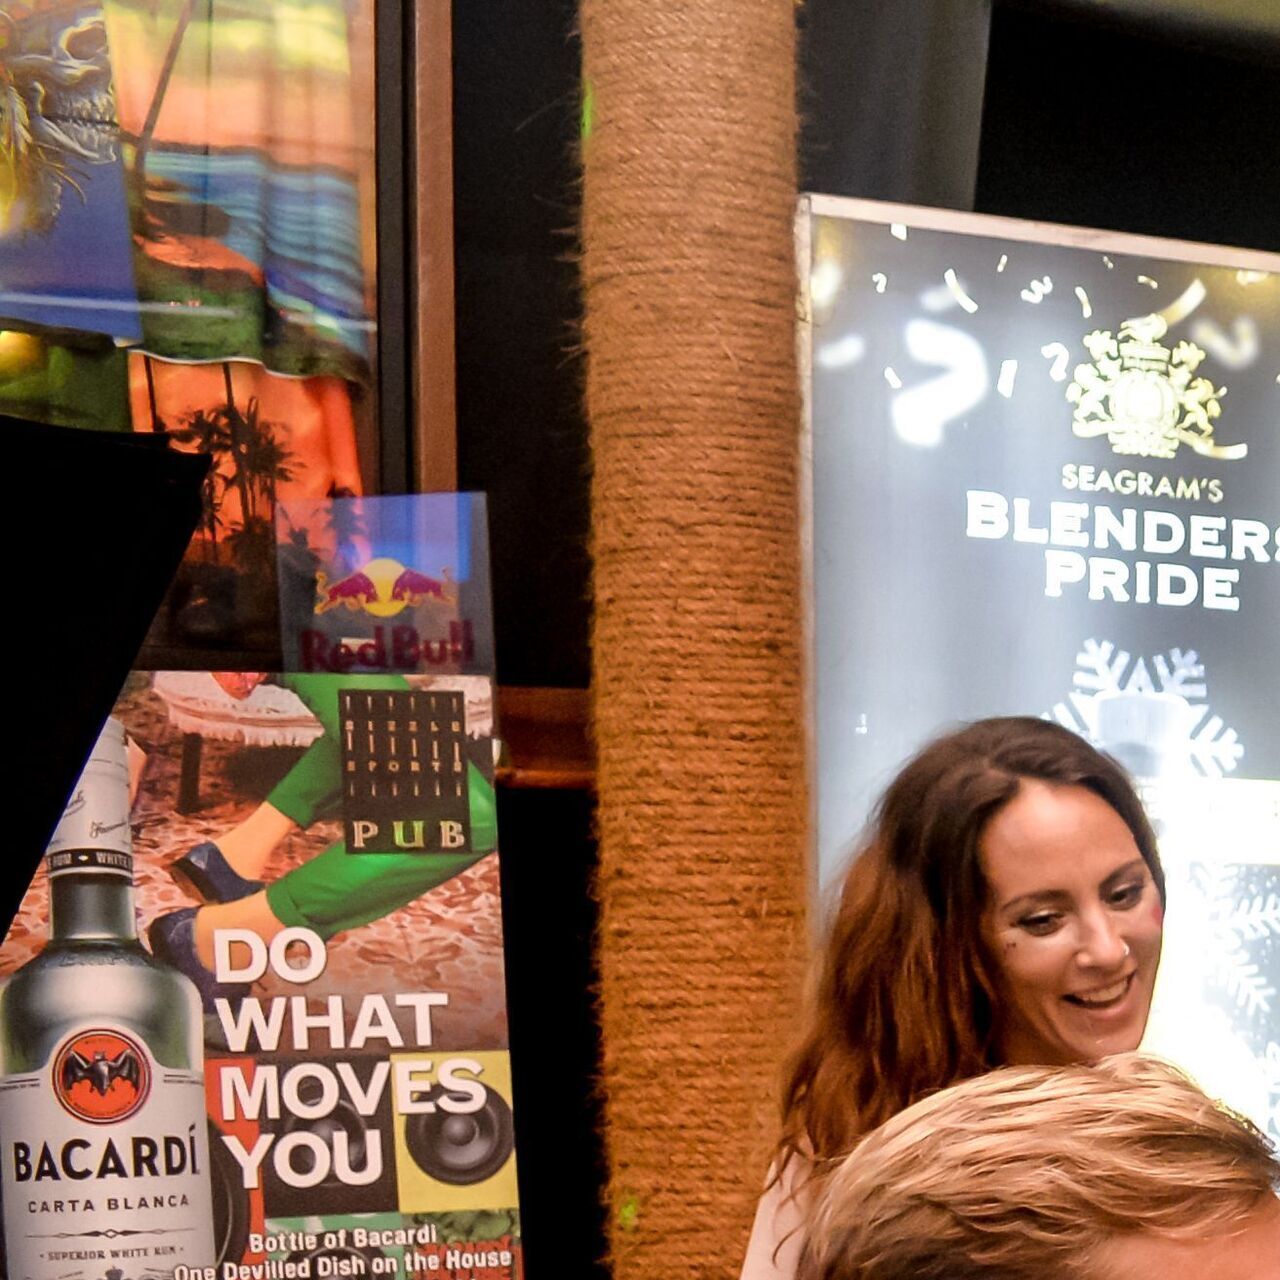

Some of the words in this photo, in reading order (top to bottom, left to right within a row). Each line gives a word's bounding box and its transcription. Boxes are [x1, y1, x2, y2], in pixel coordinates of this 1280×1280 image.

[1061, 463, 1225, 503] SEAGRAM'S
[1044, 549, 1240, 611] PRIDE
[353, 820, 465, 848] PUB
[213, 926, 327, 984] DO
[214, 992, 448, 1052] WHAT
[219, 1058, 488, 1121] MOVES
[13, 1123, 201, 1183] BACARDÍ
[220, 1128, 383, 1189] YOU
[28, 1199, 95, 1214] CARTA
[107, 1194, 190, 1211] BLANCA
[48, 1250, 106, 1261] SUPERIOR
[110, 1248, 149, 1258] WHITE
[154, 1246, 176, 1255] RUM
[249, 1232, 317, 1253] Bottle
[324, 1229, 347, 1249] of
[353, 1224, 437, 1247] Bacardi
[317, 1255, 365, 1277] Dish
[372, 1257, 398, 1274] on
[405, 1252, 440, 1272] the
[446, 1249, 512, 1269] House
